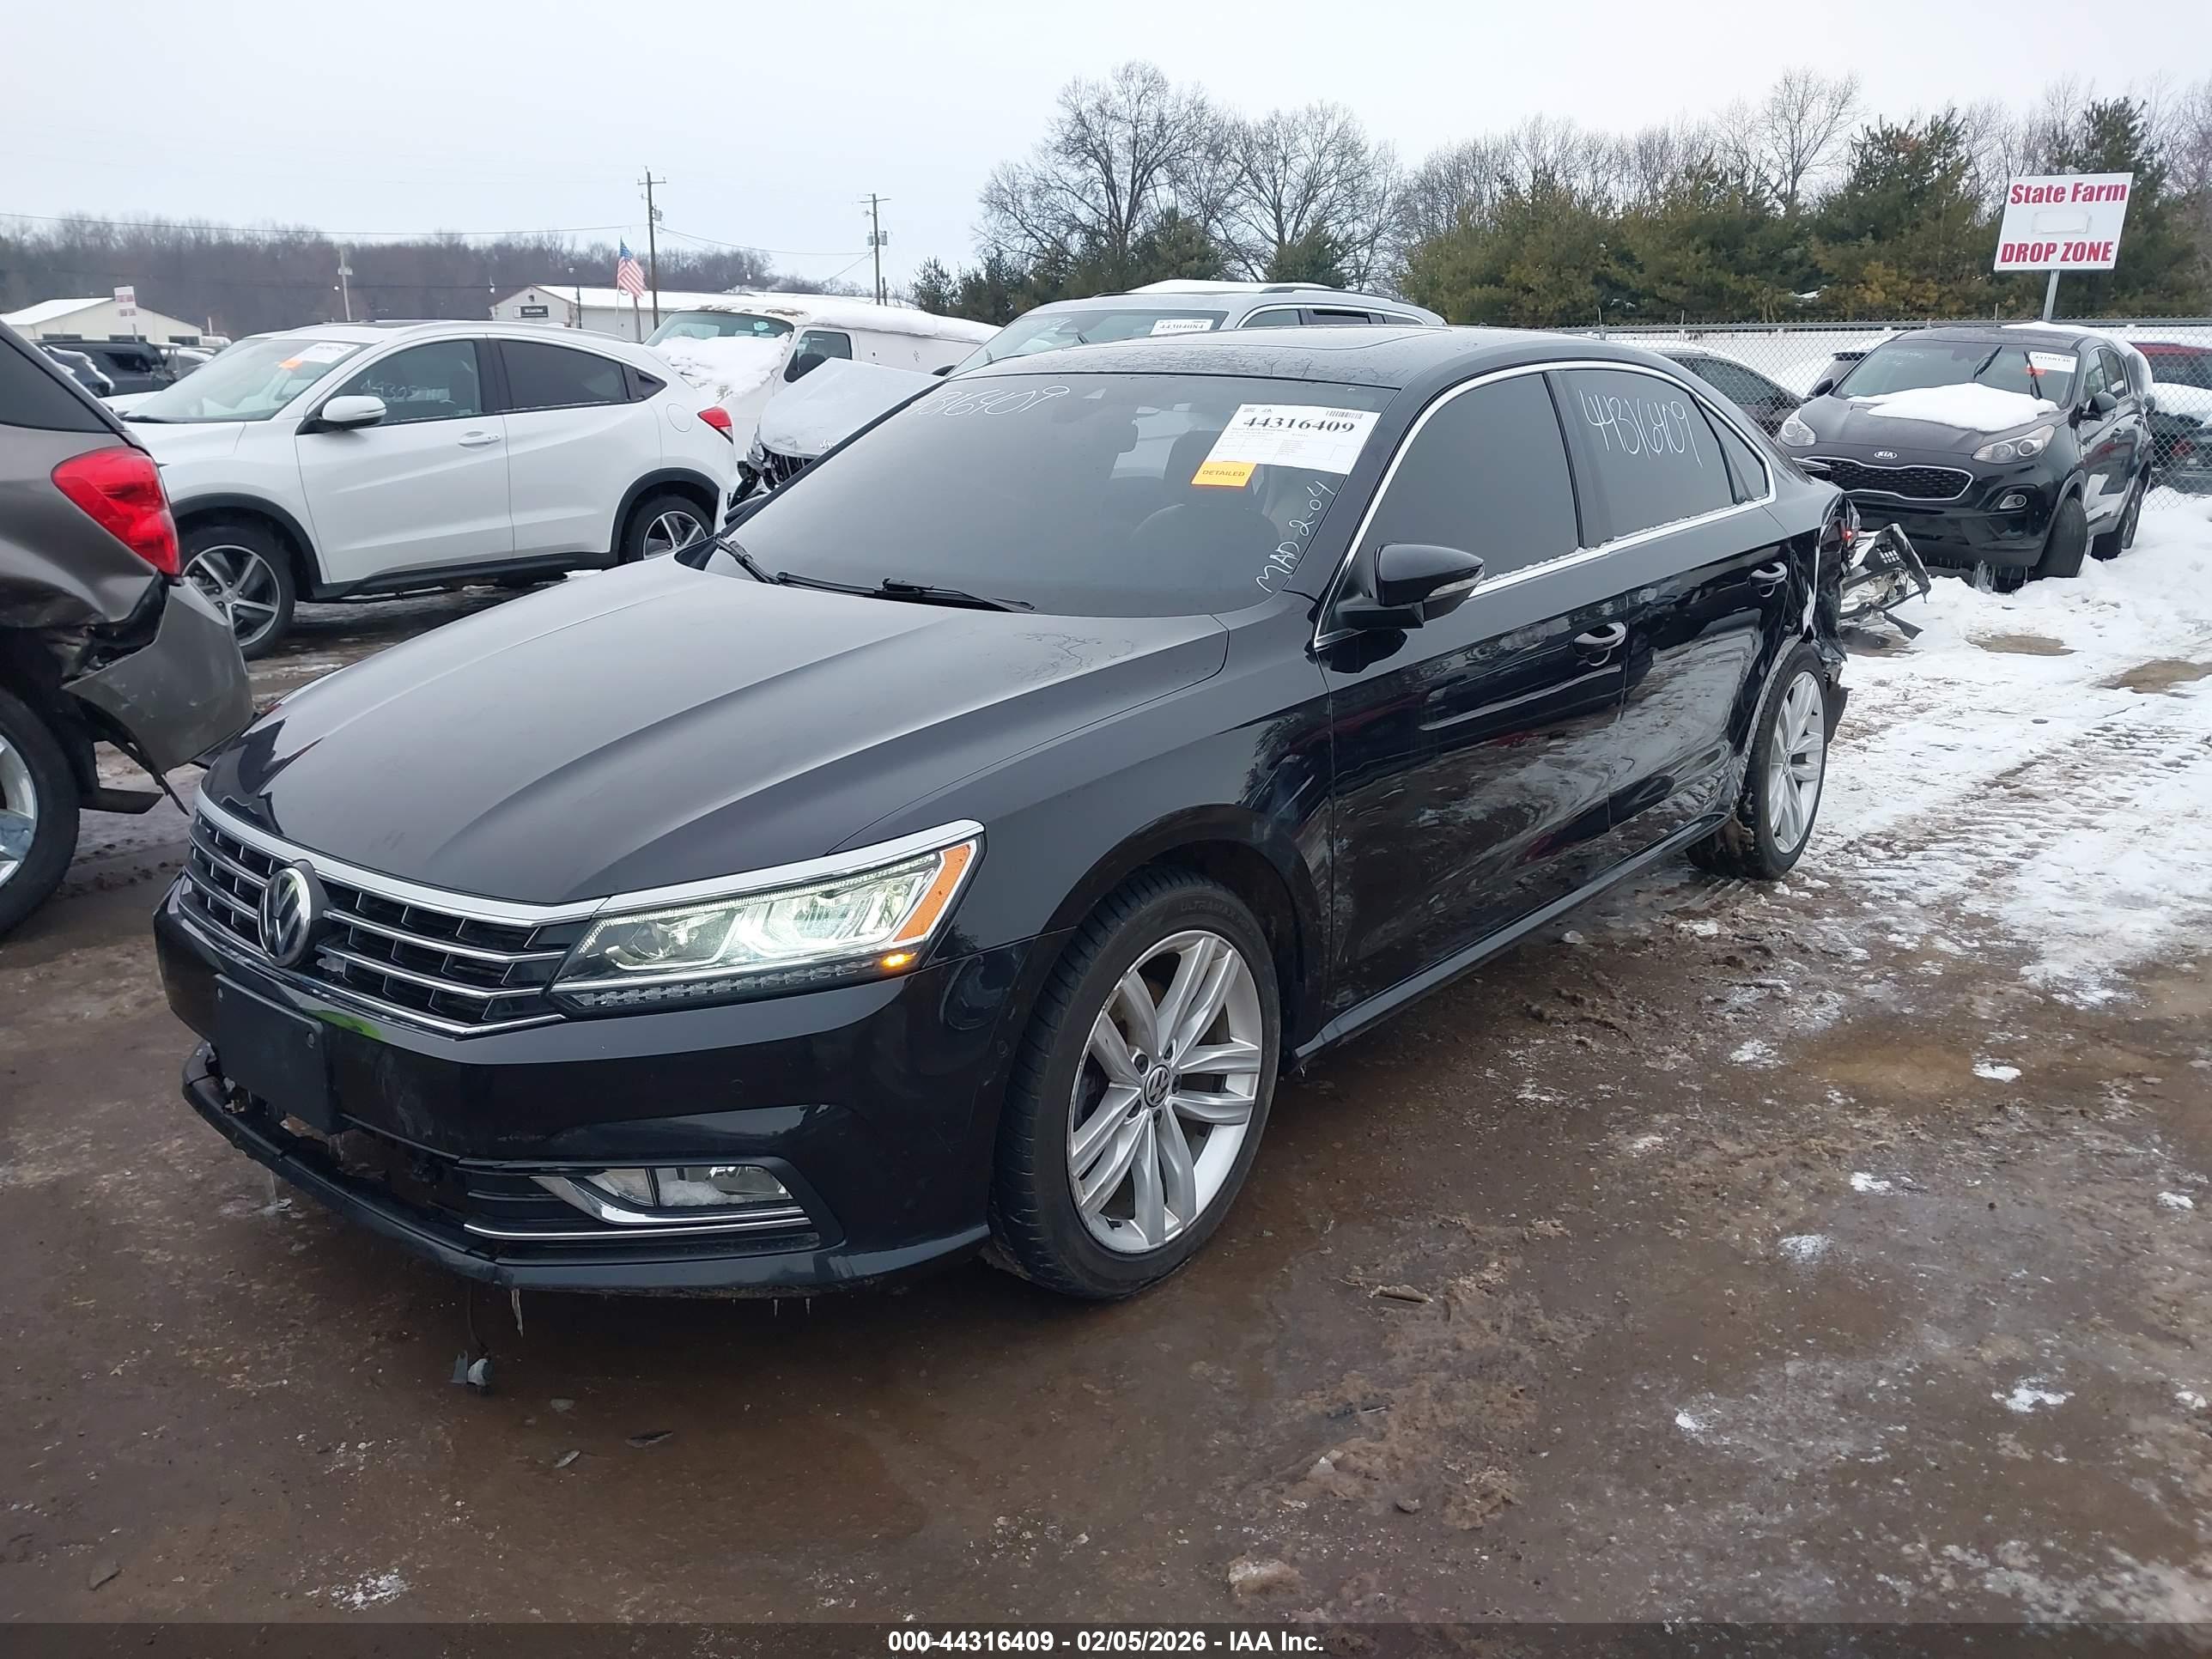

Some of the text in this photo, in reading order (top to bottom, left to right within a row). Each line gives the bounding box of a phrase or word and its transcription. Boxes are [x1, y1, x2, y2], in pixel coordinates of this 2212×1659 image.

[2010, 182, 2127, 204] State Farm
[2001, 241, 2113, 263] DROP ZONE
[1243, 416, 1355, 434] 44316409
[1579, 389, 1703, 468] 44316409
[1256, 541, 1301, 592] MAD
[1289, 480, 1337, 537] 2-04
